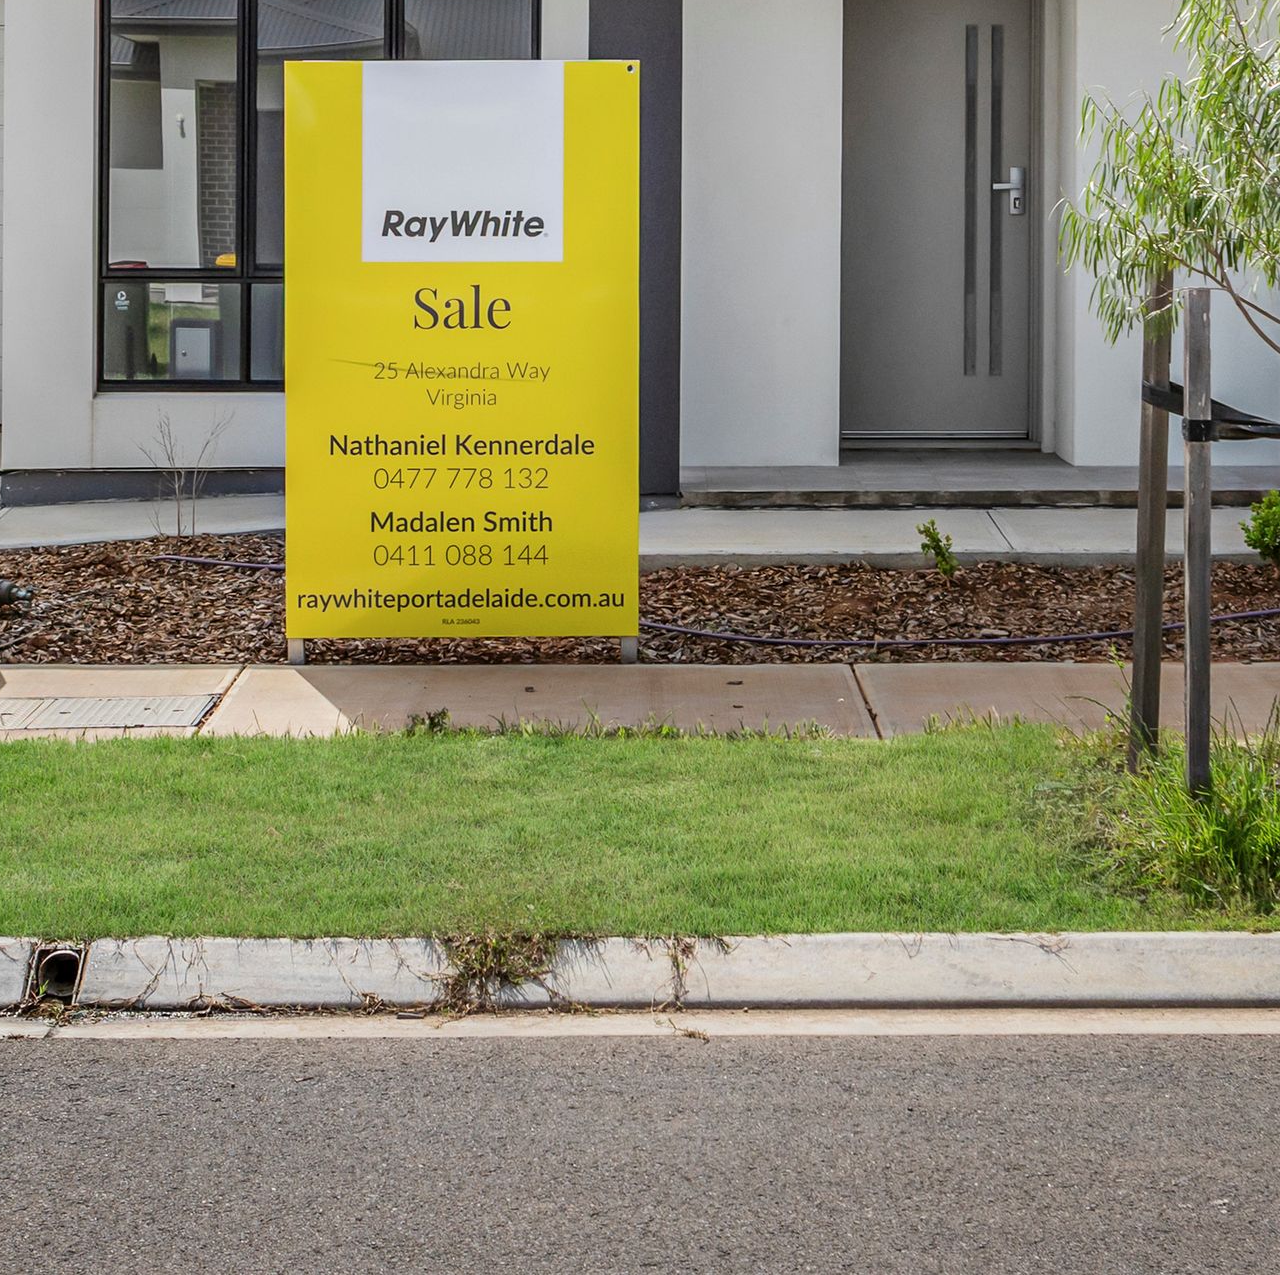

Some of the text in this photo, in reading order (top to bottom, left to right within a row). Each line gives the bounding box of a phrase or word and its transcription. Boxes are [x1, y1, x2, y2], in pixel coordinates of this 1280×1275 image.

[413, 284, 512, 330] Sale
[373, 361, 551, 383] 25 Alexandra Way
[426, 388, 497, 410] Virginia
[329, 433, 595, 456] Nathaniel Kennerdale
[373, 467, 549, 490] 0477 778 132
[370, 510, 553, 533] Madalen Smith
[373, 544, 549, 567] 0411 088 144
[297, 587, 625, 613] raywhiteportadelaide.com.au
